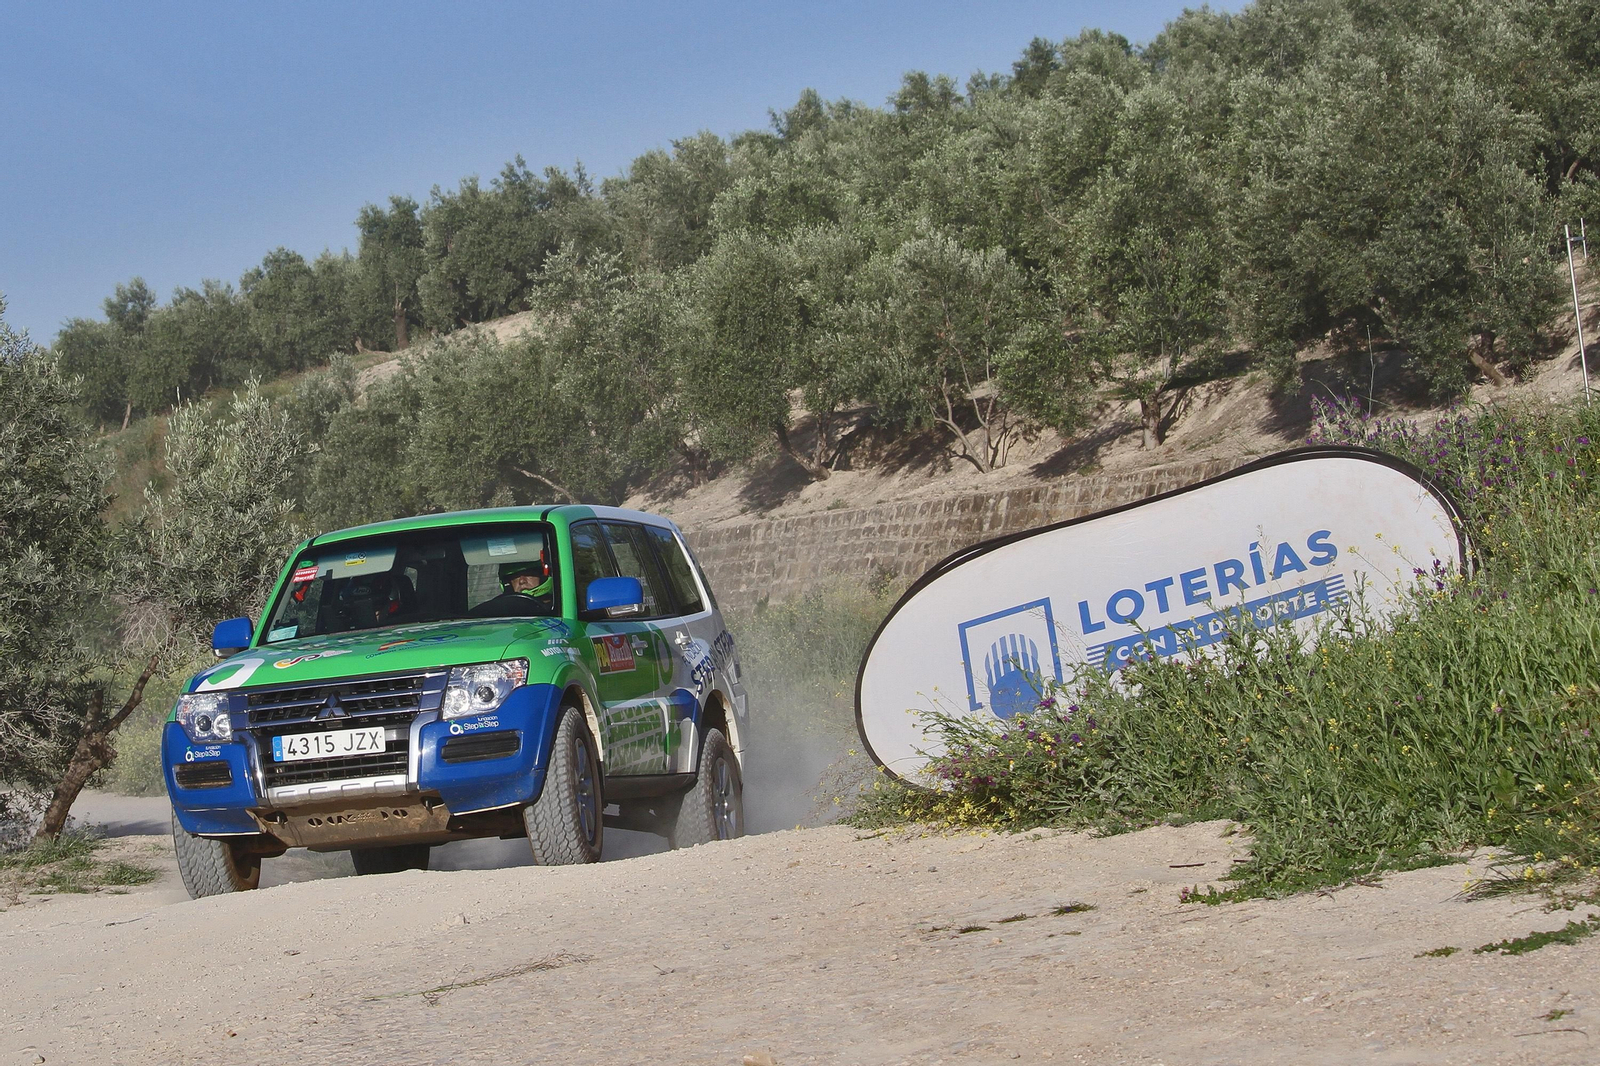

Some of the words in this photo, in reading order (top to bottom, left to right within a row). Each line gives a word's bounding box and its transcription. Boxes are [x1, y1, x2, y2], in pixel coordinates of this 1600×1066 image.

[1077, 529, 1338, 636] LOTERÍAS
[1115, 632, 1167, 661] CON
[287, 734, 335, 756] 4315
[343, 731, 379, 751] JZX
